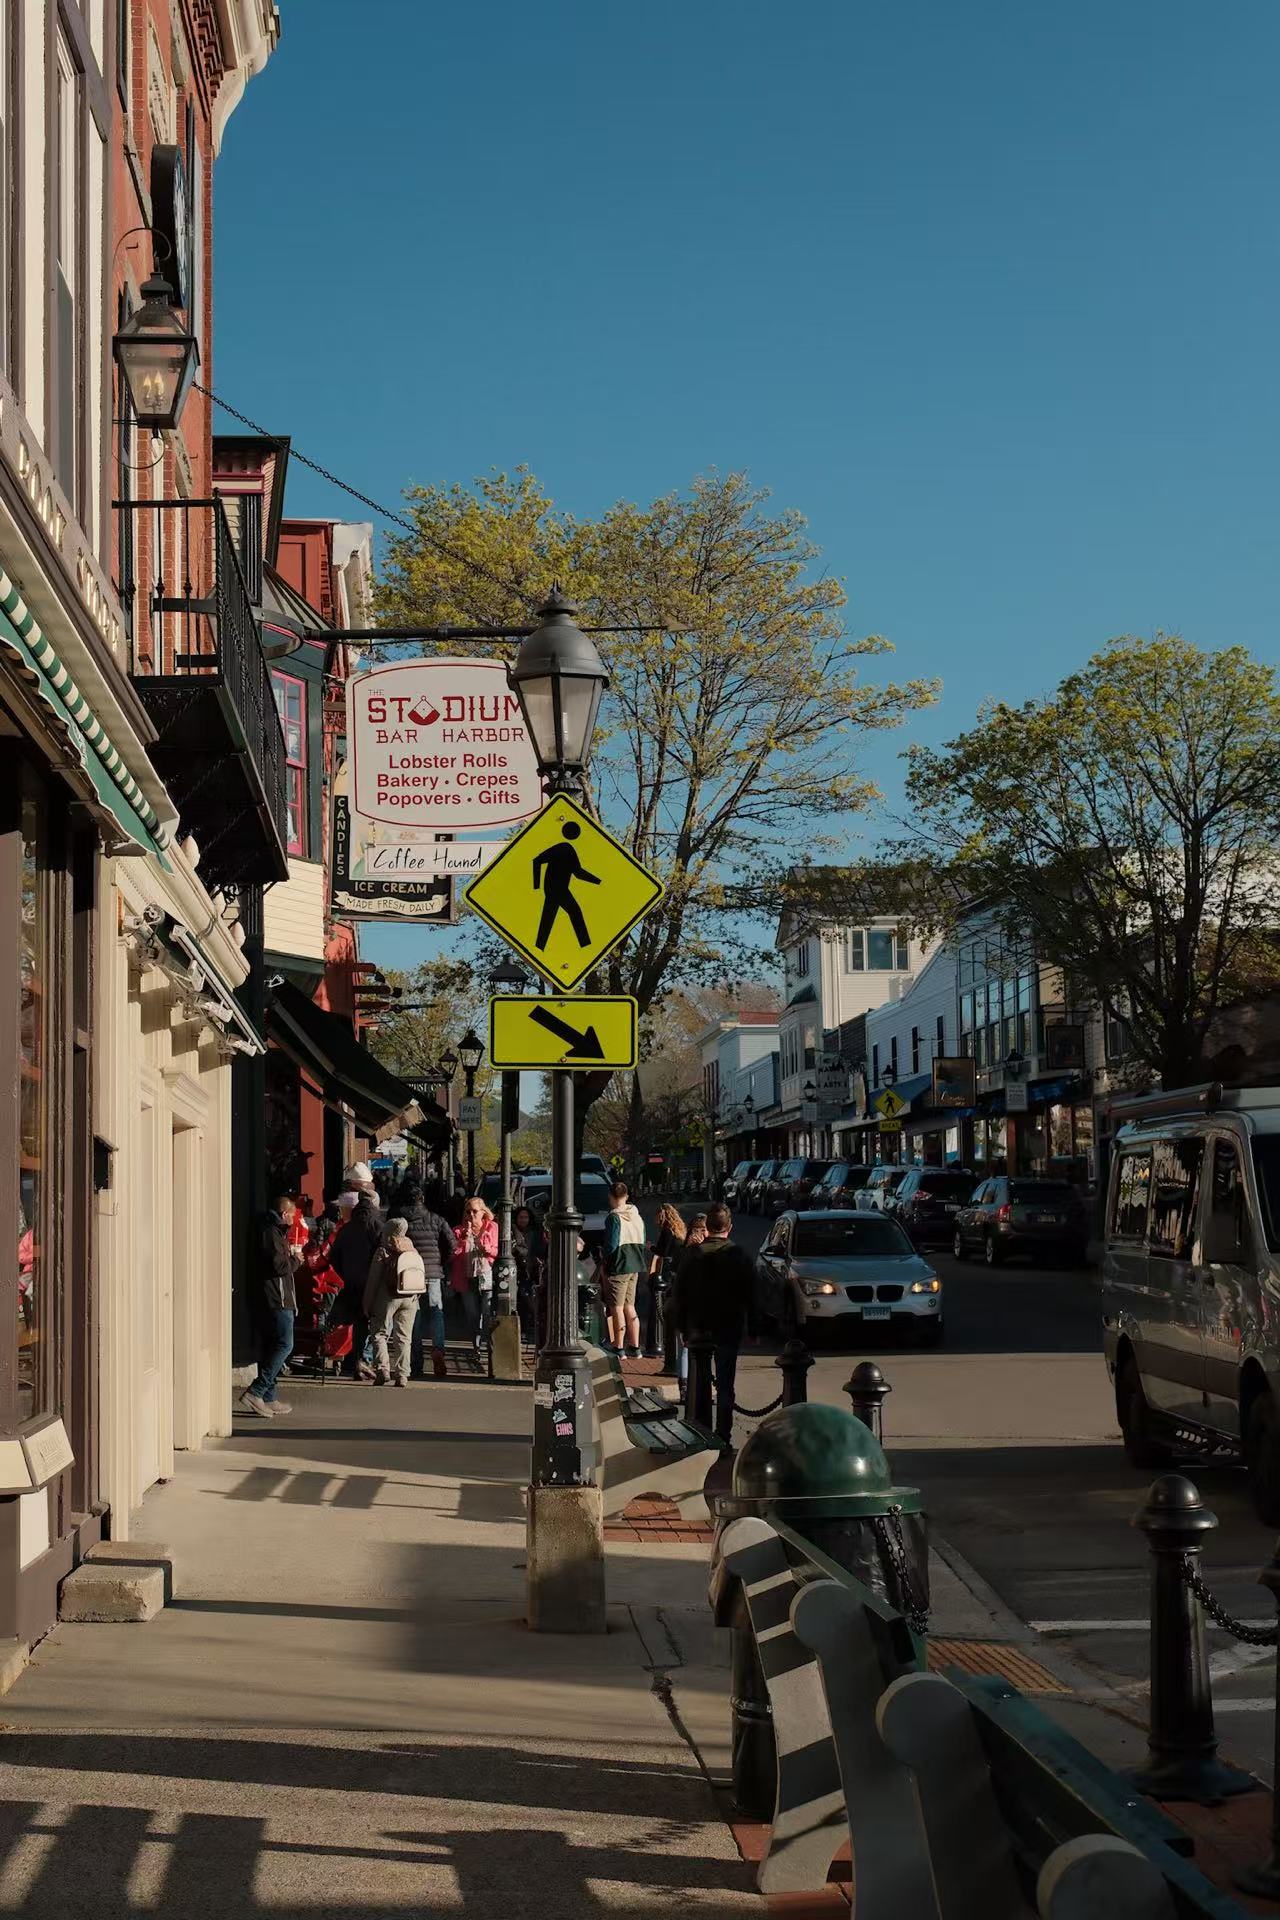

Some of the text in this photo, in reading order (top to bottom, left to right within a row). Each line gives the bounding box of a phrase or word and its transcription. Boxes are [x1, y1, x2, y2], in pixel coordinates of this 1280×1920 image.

[376, 727, 525, 743] BAR HARBOR
[389, 753, 508, 769] Lobster Rolls
[377, 772, 519, 790] Bakery Crepes
[377, 790, 520, 808] Popovers Gifts
[336, 797, 347, 876] CANDIES
[373, 846, 482, 869] Coffee Hound
[355, 881, 427, 894] ICE CREAM
[346, 898, 435, 913] MADE FRESH DAILY
[462, 1105, 478, 1114] PAY
